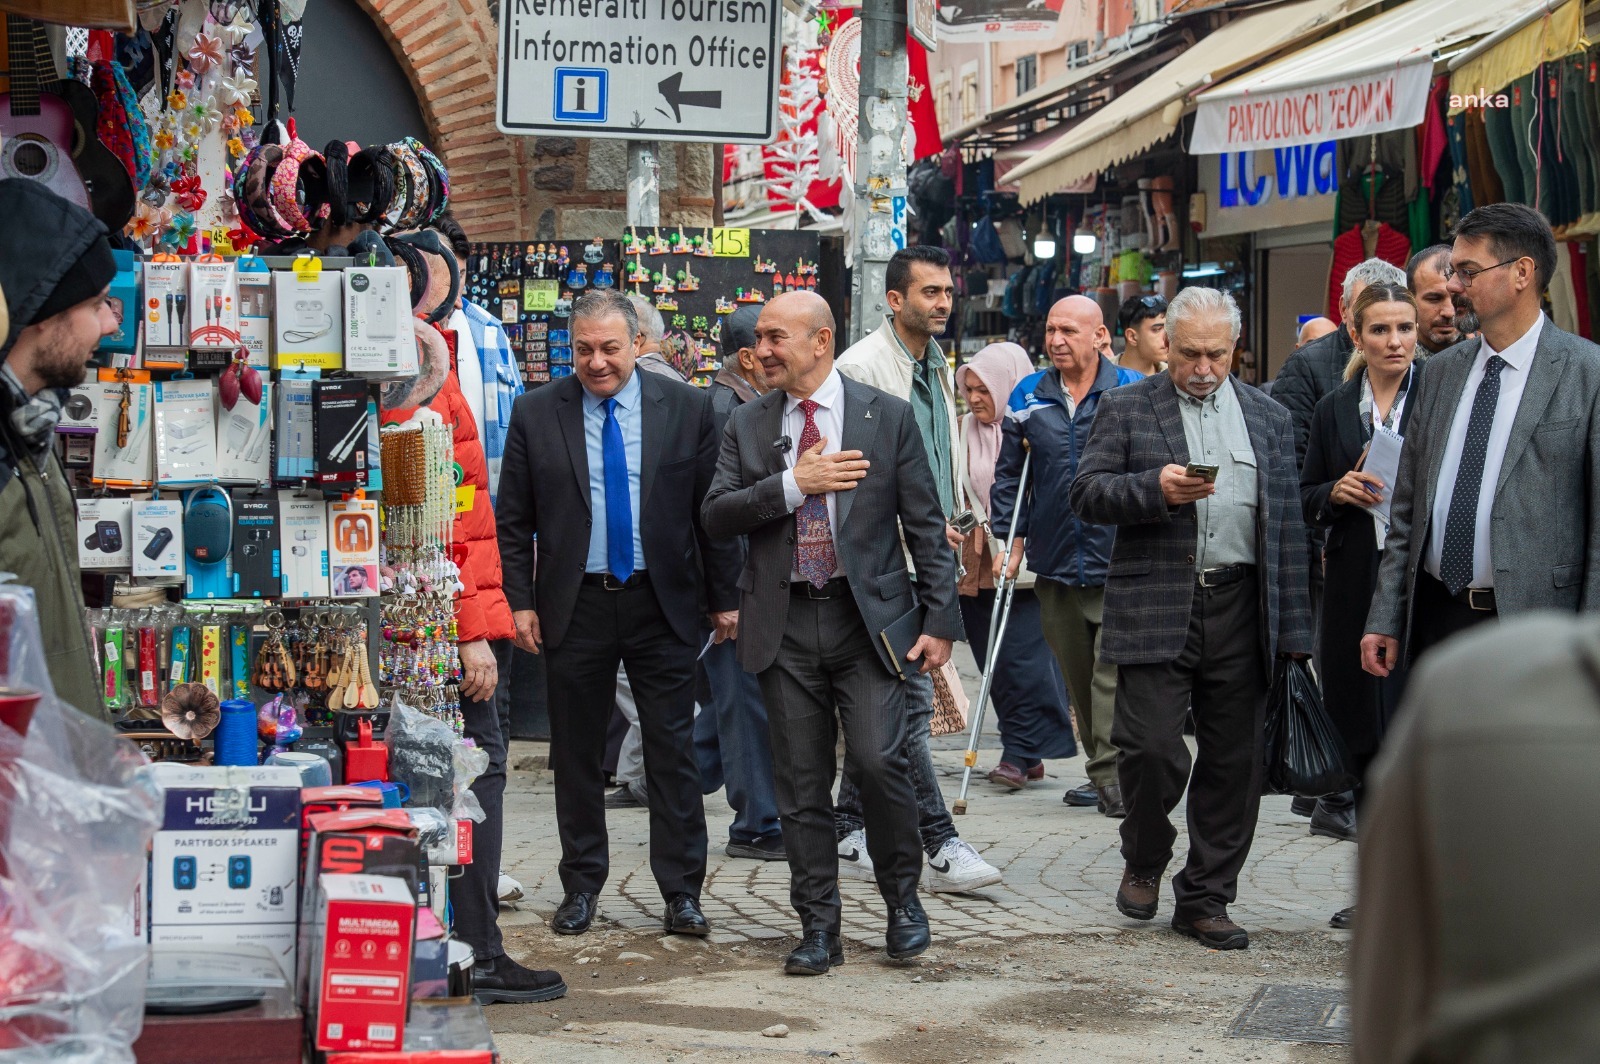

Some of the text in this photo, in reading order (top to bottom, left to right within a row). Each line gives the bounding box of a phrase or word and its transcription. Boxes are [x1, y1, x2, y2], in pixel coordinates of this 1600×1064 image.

[660, 0, 766, 24] Tourism
[688, 35, 766, 69] Office
[1227, 77, 1394, 143] PANTOLONCU TEOMAN
[213, 229, 223, 244] 45
[715, 229, 743, 256] 15
[527, 291, 547, 308] 25
[175, 838, 278, 847] PARTYBOX SPEAKER
[338, 917, 399, 928] MULTIMEDIA
[370, 928, 400, 936] SPEAKER
[372, 988, 395, 996] BROWN
